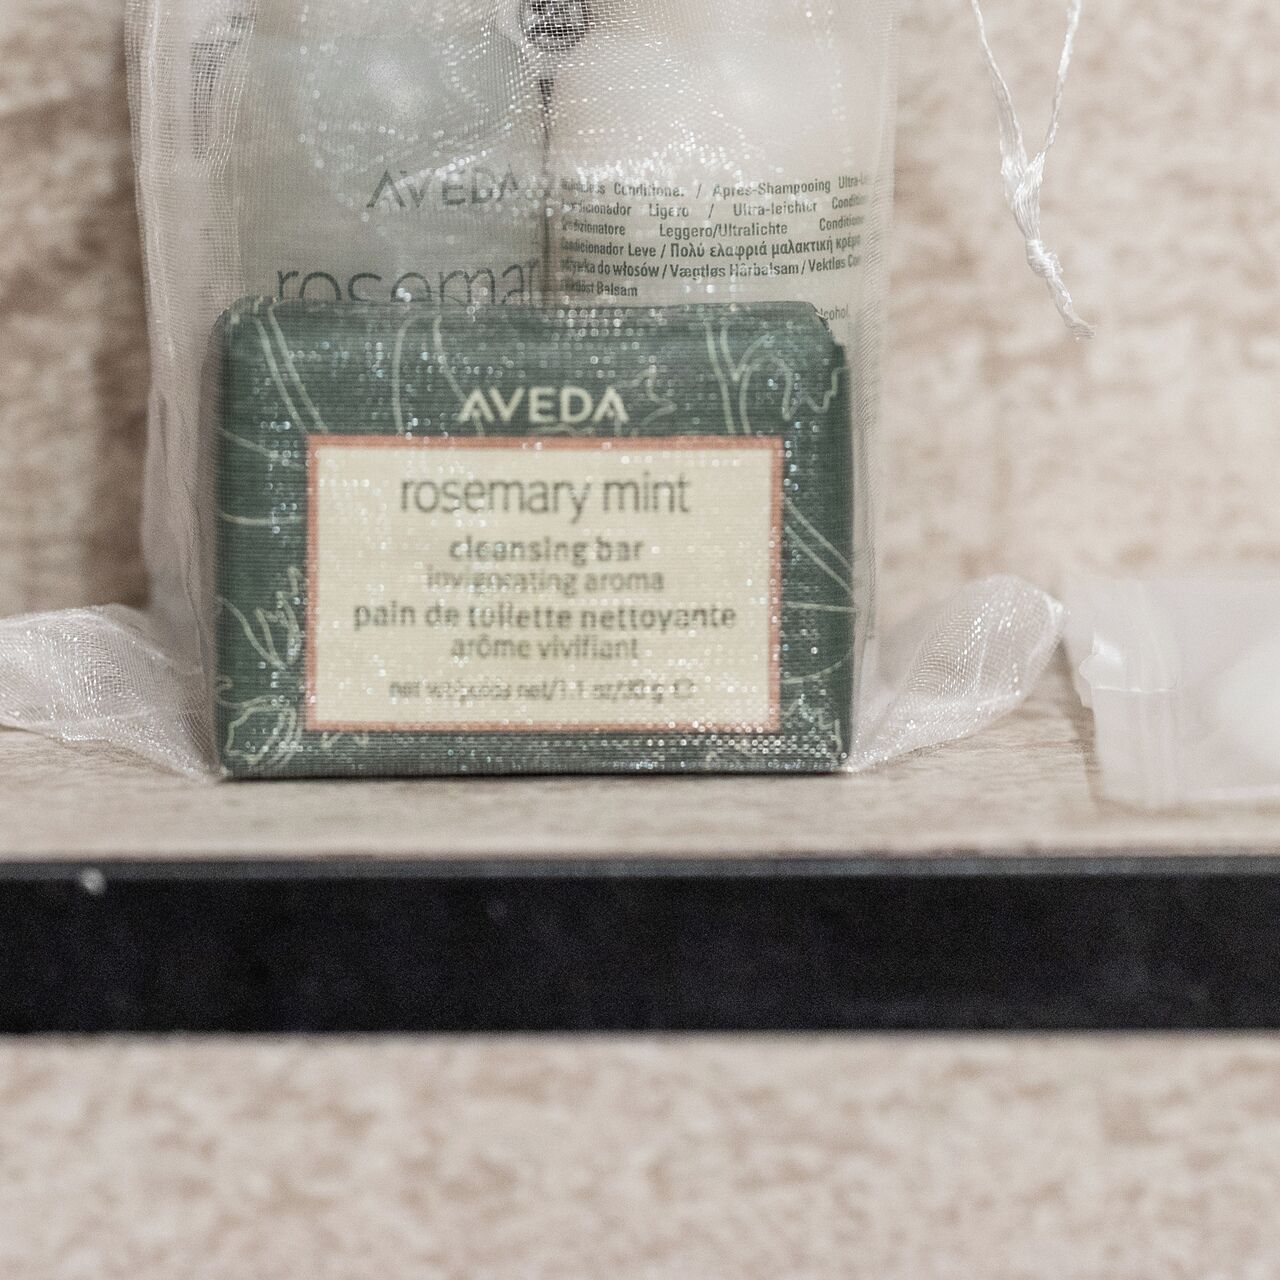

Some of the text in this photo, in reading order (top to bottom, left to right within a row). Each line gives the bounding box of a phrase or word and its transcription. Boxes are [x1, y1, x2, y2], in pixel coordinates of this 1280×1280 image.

[366, 163, 519, 208] AVEDA
[659, 222, 788, 240] Leggero/Ultralichte
[560, 236, 624, 255] dicionador
[628, 243, 656, 257] Leve
[670, 242, 705, 258] Πολύ
[709, 240, 768, 261] ελαφριά
[771, 235, 833, 260] μαλακτική
[277, 258, 540, 303] rosemar
[598, 260, 610, 275] do
[613, 261, 660, 277] włosów
[670, 264, 726, 280] Vægtløs
[809, 256, 846, 273] Vektløs
[596, 280, 638, 296] Balsam
[457, 385, 629, 423] AVEDA
[401, 471, 690, 523] rosemary mint
[449, 534, 644, 566] cleansing bar
[584, 572, 665, 592] aroma
[354, 600, 416, 631] pain
[424, 602, 459, 627] de
[580, 604, 736, 634] nettoyante
[451, 633, 638, 660] arôme vivifiant
